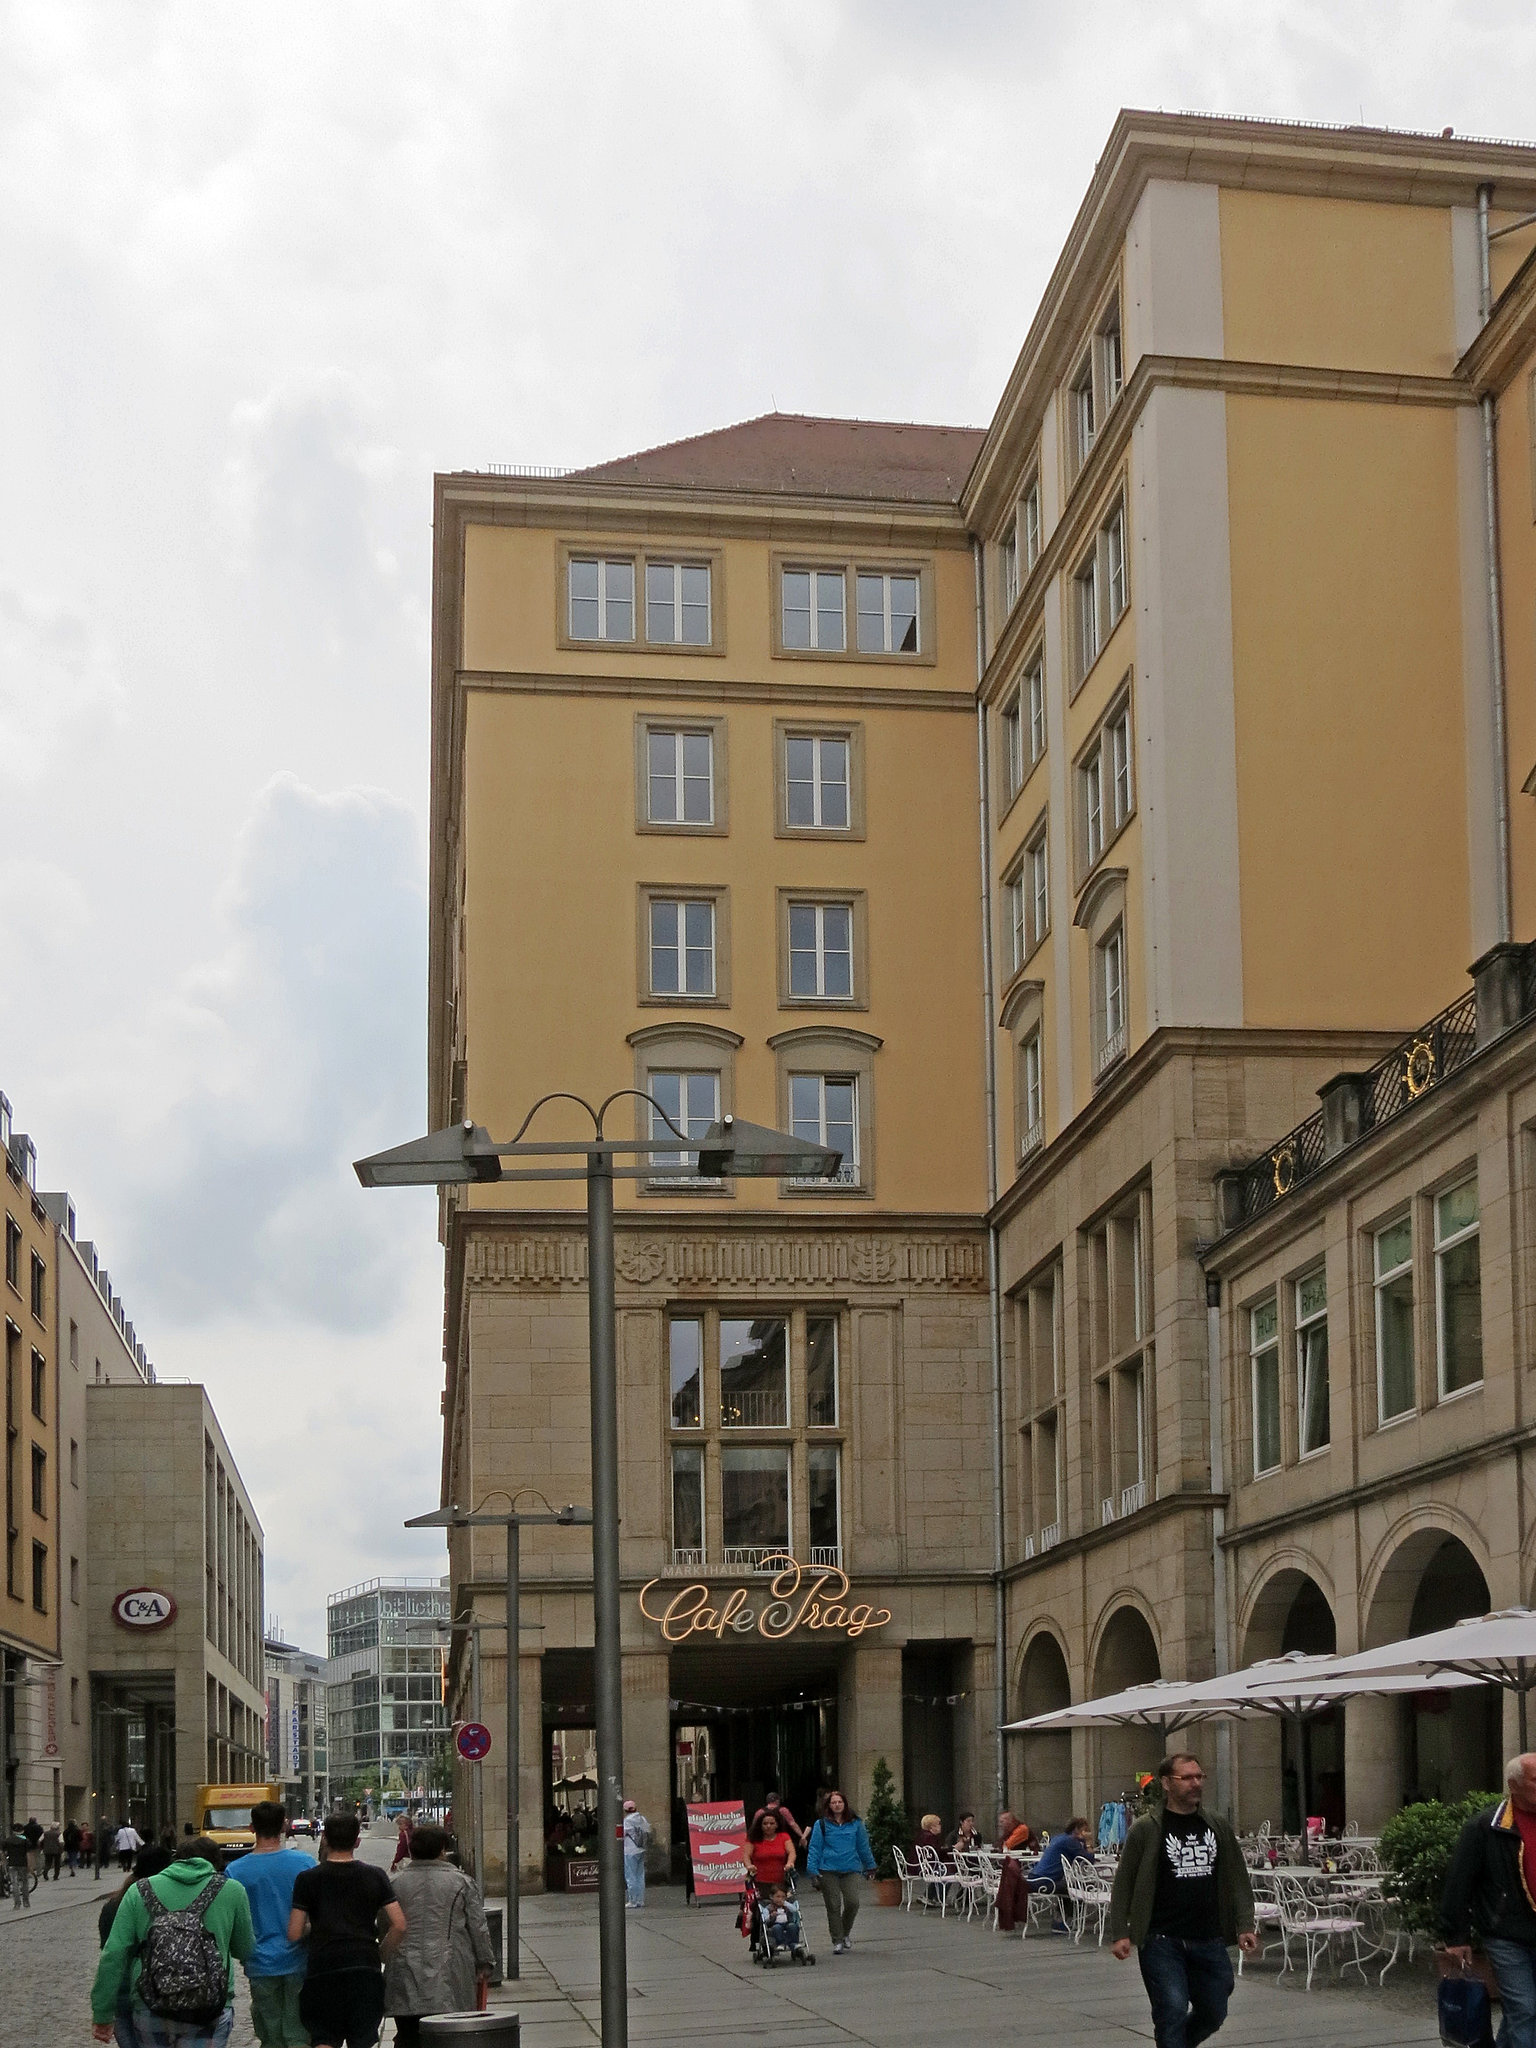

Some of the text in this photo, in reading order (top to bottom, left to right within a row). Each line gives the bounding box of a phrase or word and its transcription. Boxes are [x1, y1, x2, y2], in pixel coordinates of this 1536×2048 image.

[663, 1563, 752, 1577] MARKTHALLE
[757, 1554, 892, 1640] Prag
[124, 1599, 165, 1617] C&A
[1181, 1845, 1209, 1867] 25
